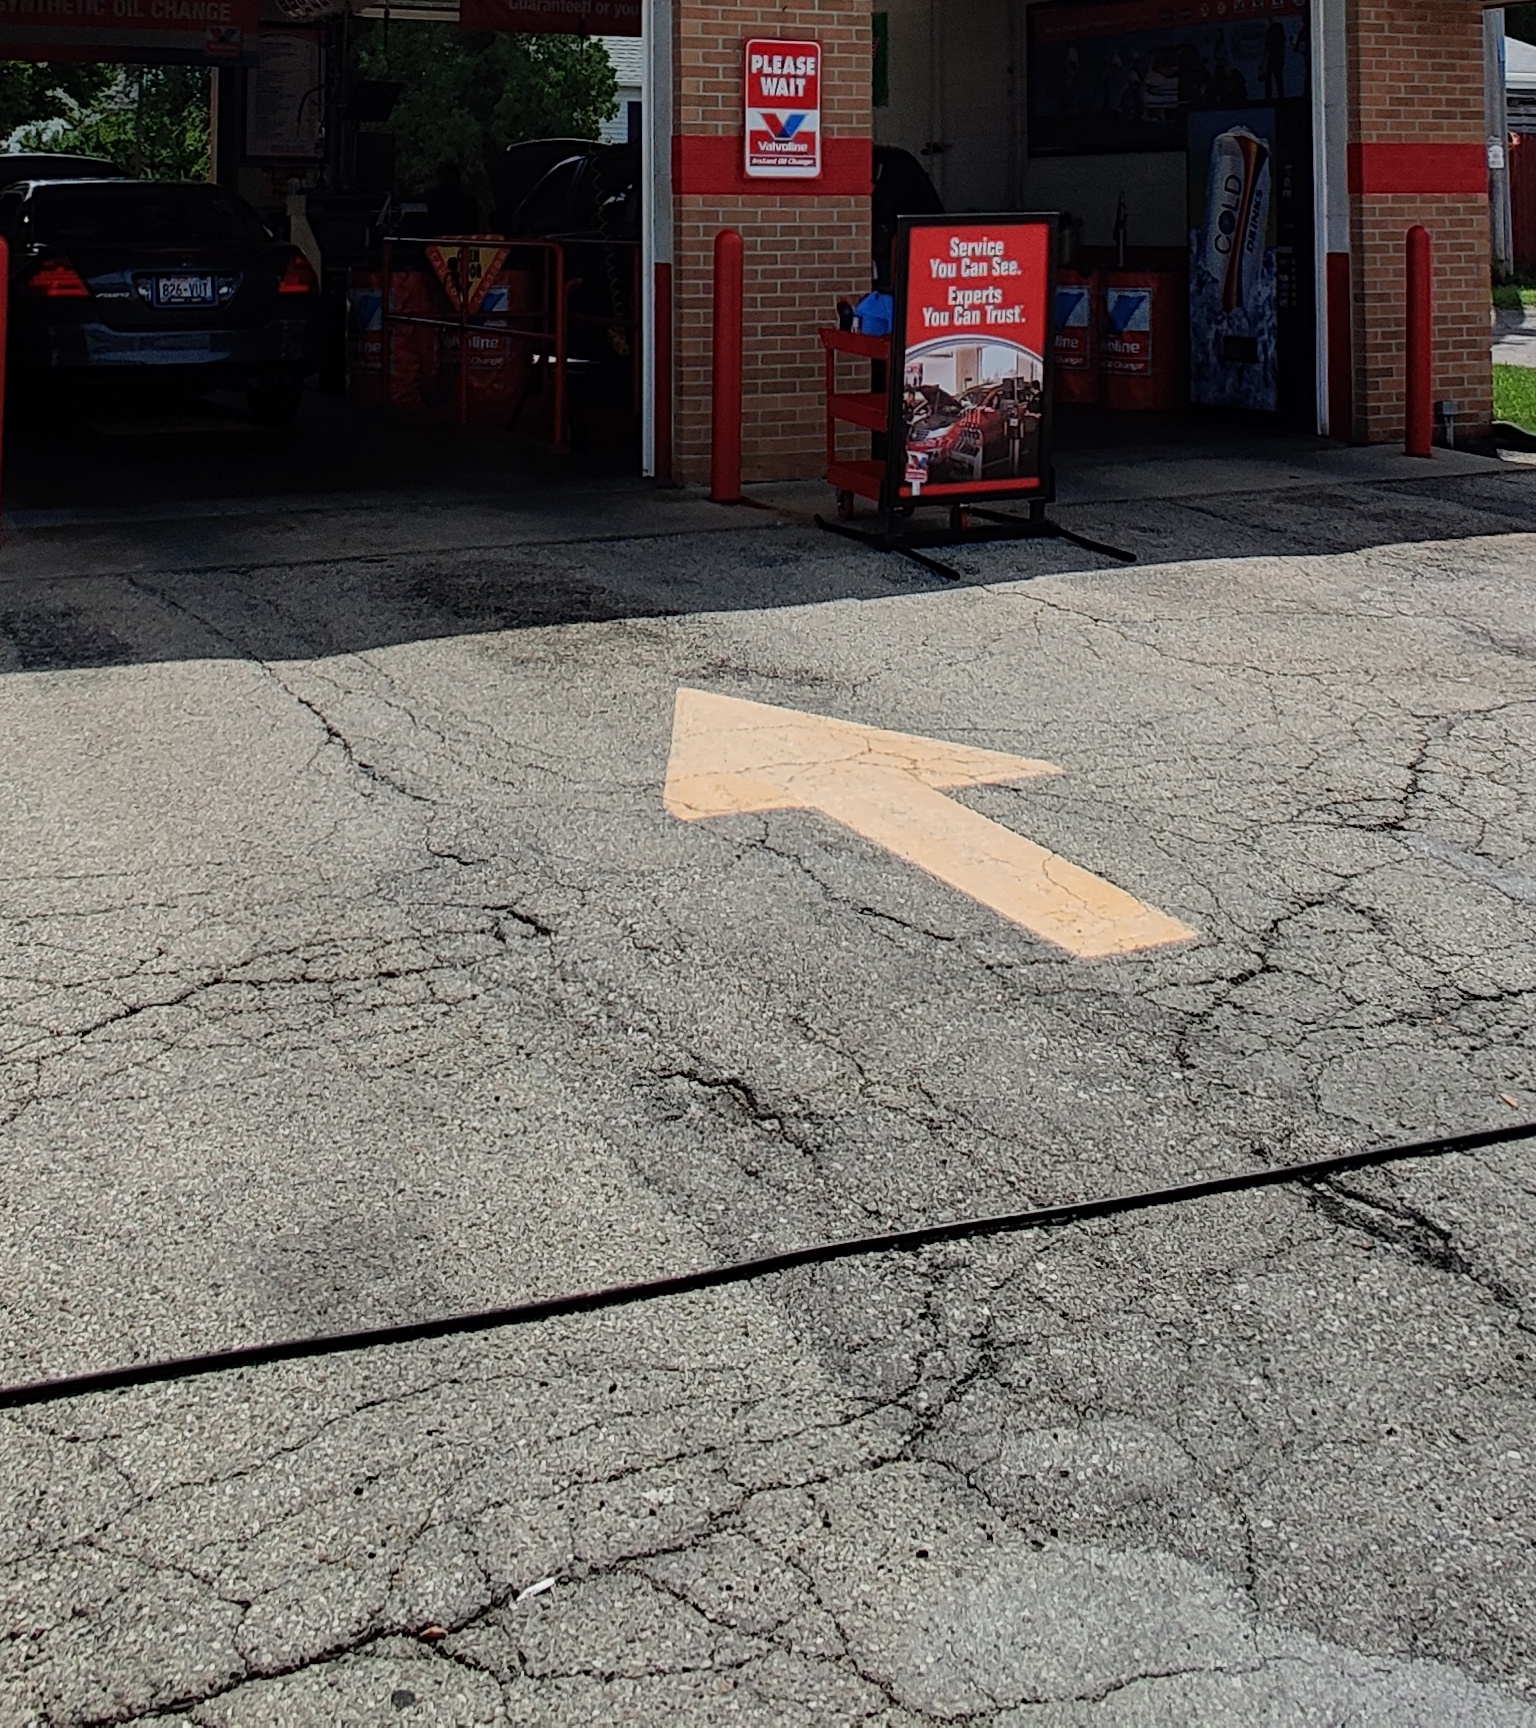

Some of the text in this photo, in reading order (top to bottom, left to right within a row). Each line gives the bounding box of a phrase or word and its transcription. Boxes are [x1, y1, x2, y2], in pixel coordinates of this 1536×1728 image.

[151, 0, 232, 22] CHANGE
[595, 1, 611, 15] or
[751, 54, 816, 76] PLEASE
[760, 76, 806, 97] WAIT
[758, 141, 808, 152] Valvoline
[1215, 174, 1242, 255] COLD
[1246, 189, 1263, 254] DRINKS
[949, 236, 1005, 257] Service
[929, 256, 1022, 278] You Can See.
[948, 286, 1002, 308] Experts
[922, 307, 949, 327] You
[953, 306, 981, 325] Can
